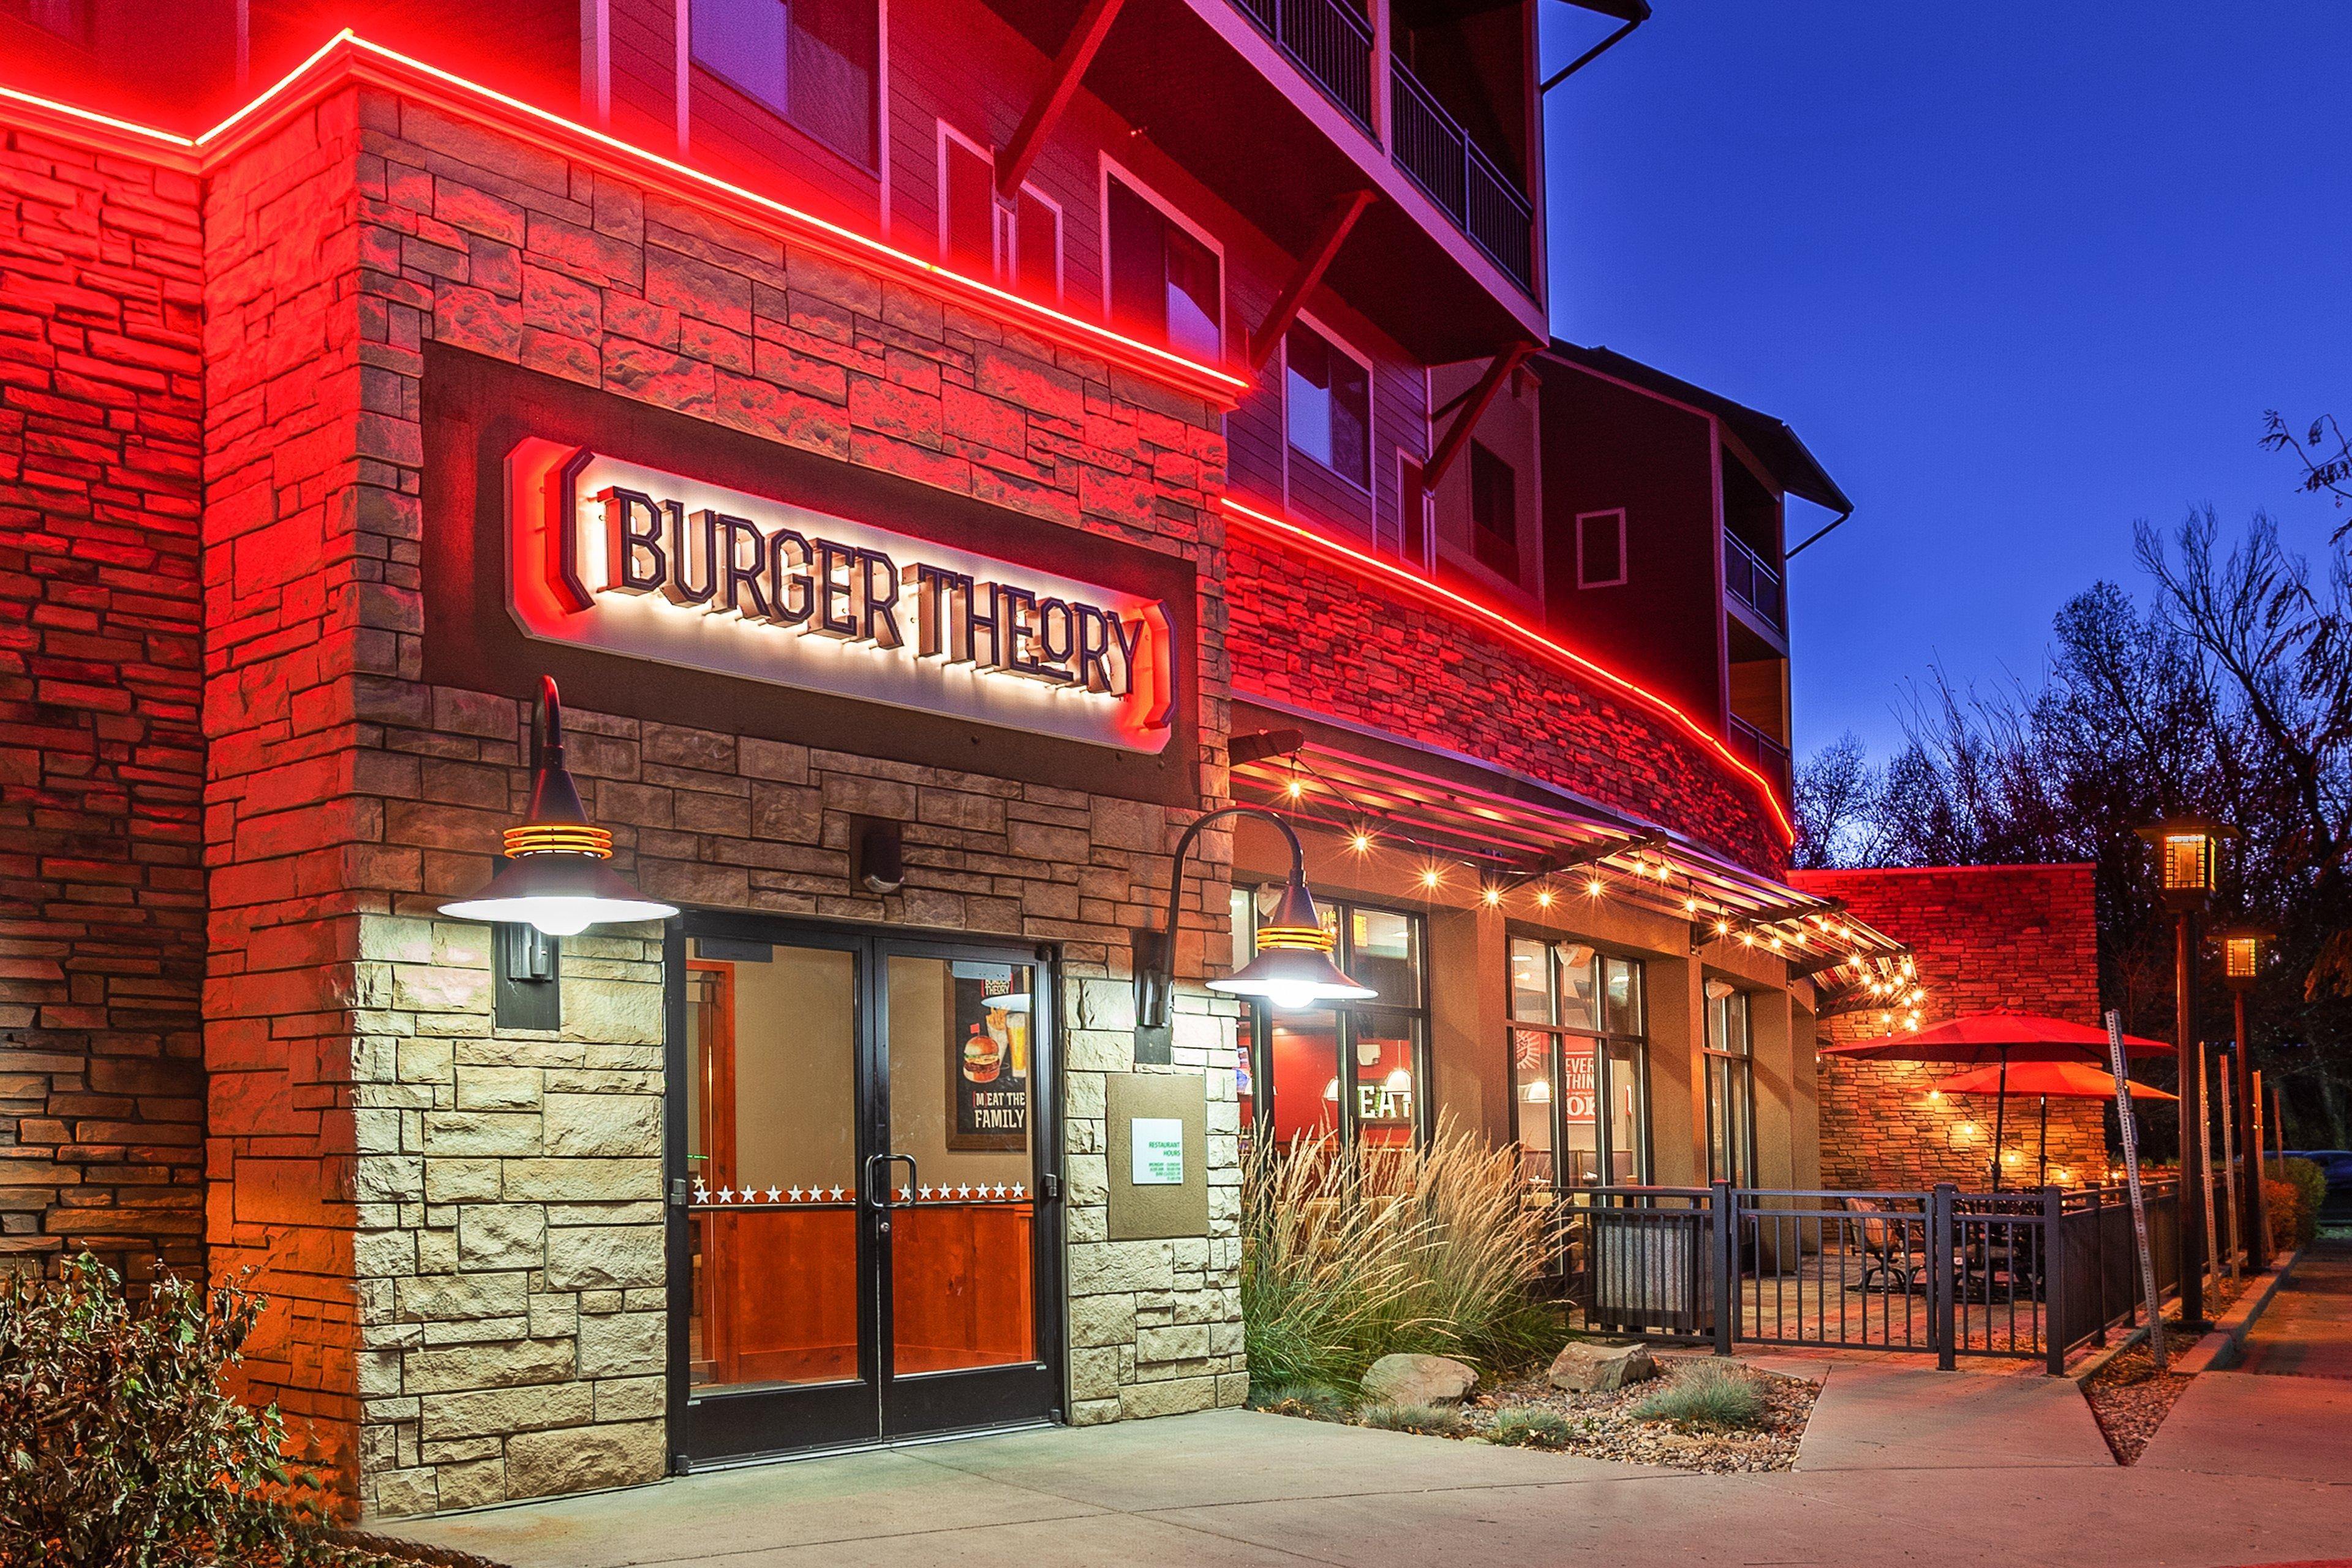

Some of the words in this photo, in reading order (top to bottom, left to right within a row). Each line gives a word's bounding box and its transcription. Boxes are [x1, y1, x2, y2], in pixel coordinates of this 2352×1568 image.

[603, 486, 905, 649] BURGER
[903, 562, 1145, 696] THEORY
[1006, 1092, 1025, 1106] THE
[974, 1109, 1025, 1128] FAMILY
